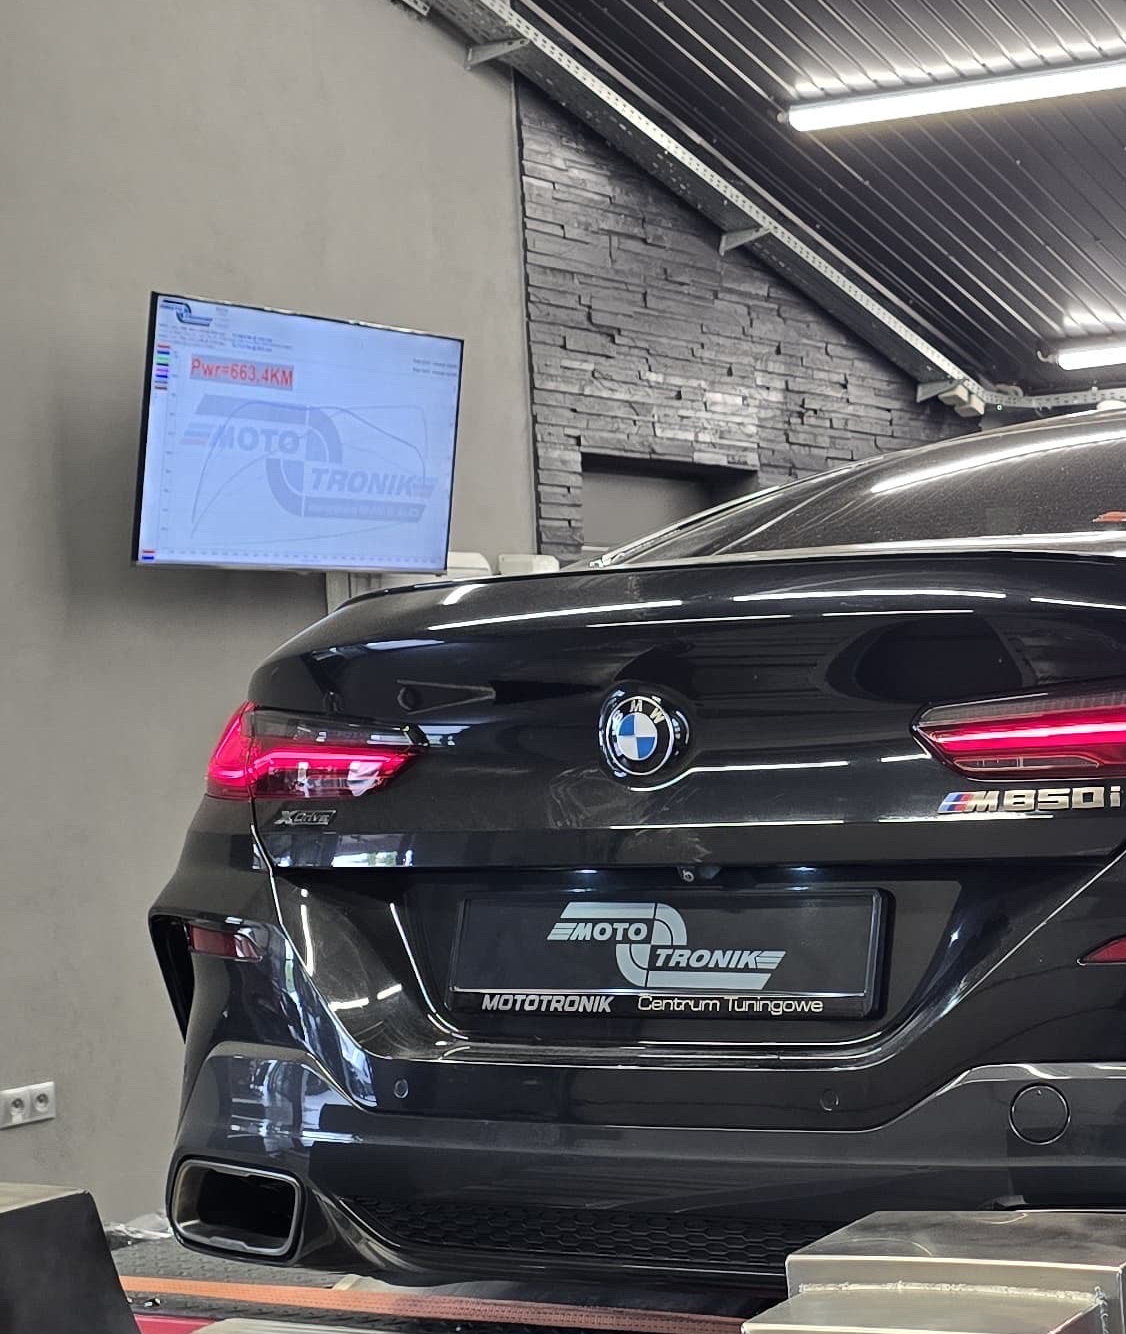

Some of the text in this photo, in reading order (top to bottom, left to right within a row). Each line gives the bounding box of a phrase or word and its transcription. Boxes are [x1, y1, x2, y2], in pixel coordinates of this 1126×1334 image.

[208, 424, 300, 454] MOTO
[310, 467, 415, 498] TRONIK
[611, 699, 665, 725] BMW
[966, 785, 1121, 813] M850i
[568, 921, 649, 942] MOTO
[655, 948, 762, 970] TRONIK
[481, 993, 824, 1016] MOTOTRONIK Centrum Tuningowe
